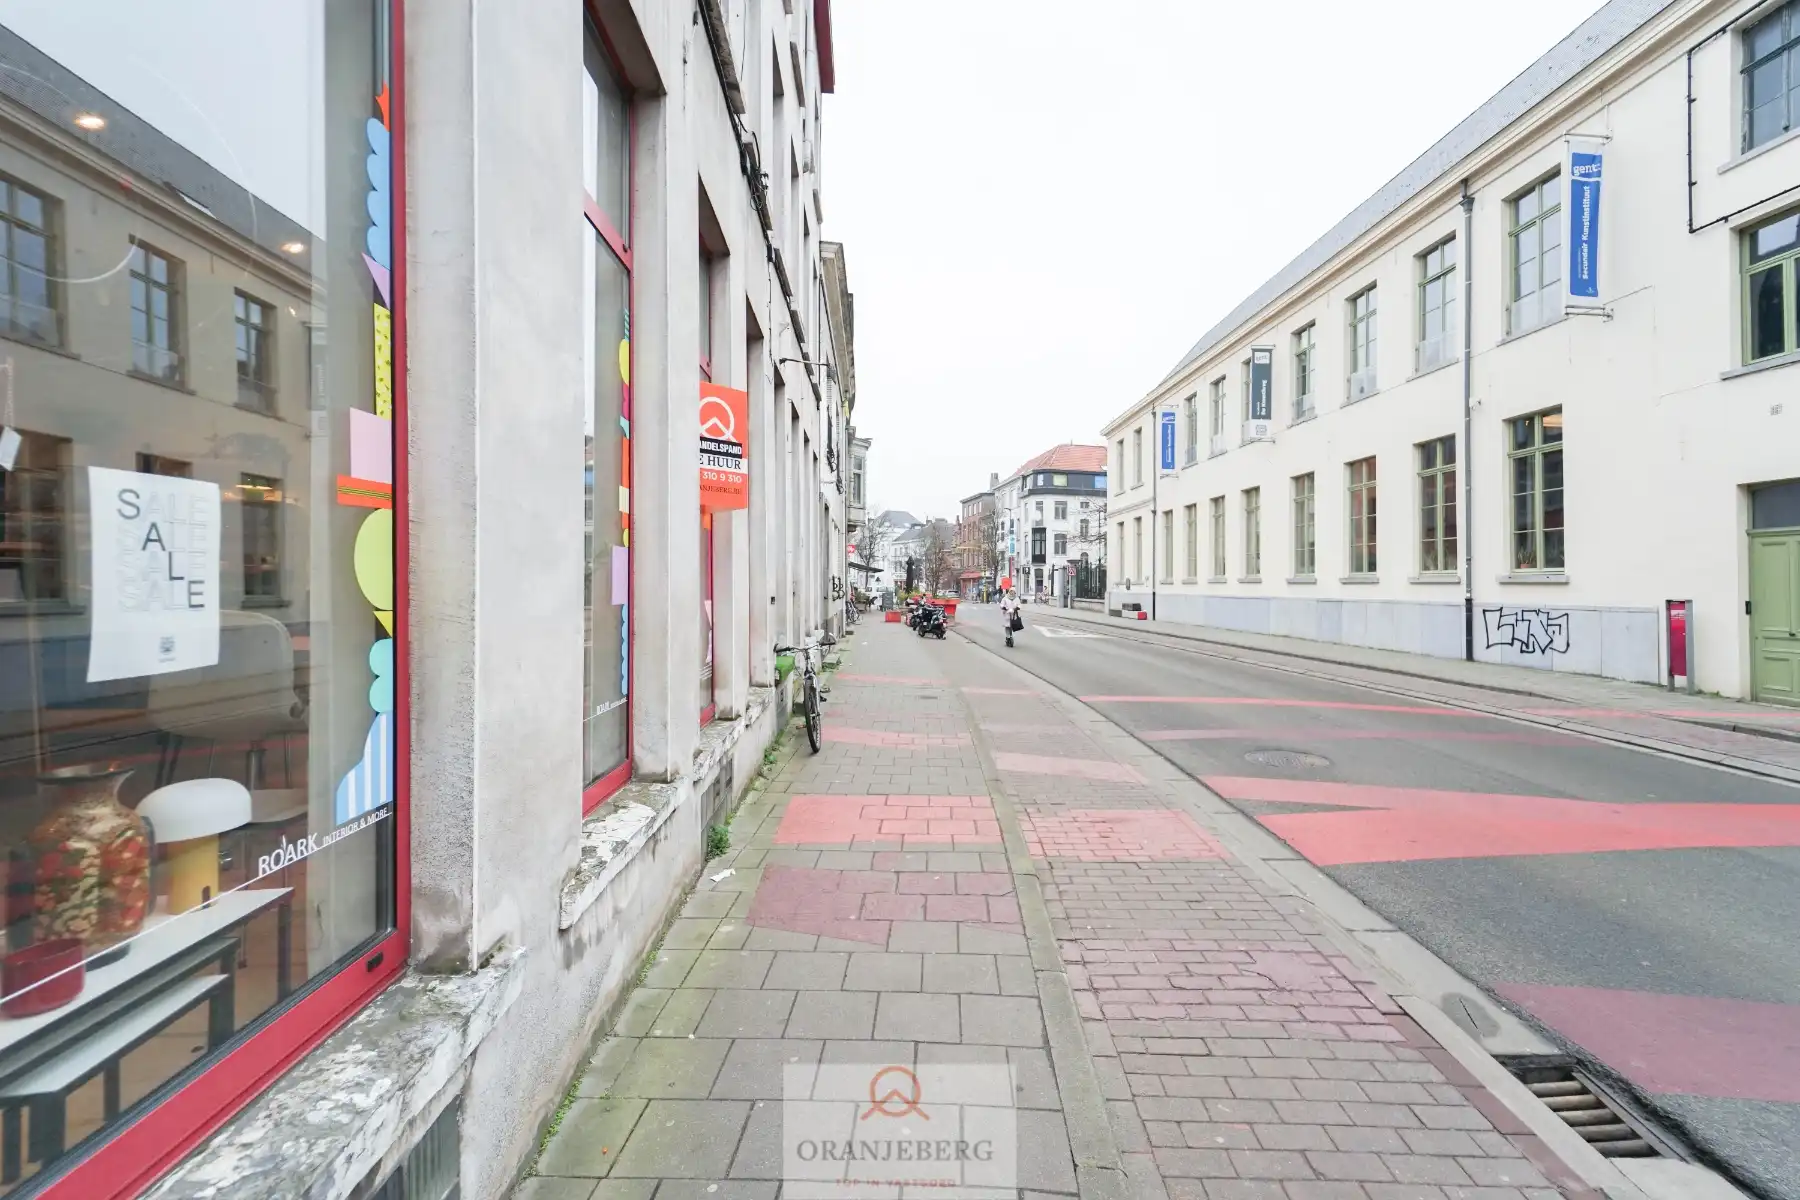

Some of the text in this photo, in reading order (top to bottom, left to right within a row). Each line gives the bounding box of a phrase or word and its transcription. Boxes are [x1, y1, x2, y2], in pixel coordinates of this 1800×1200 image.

[1582, 185, 1590, 241] Kunstinstituut
[700, 440, 742, 455] ANDELSPAND
[708, 455, 741, 470] HUUR
[702, 471, 742, 483] 310 9 310
[323, 822, 359, 846] INTERIOR
[360, 817, 366, 829] &
[367, 807, 388, 825] MORE
